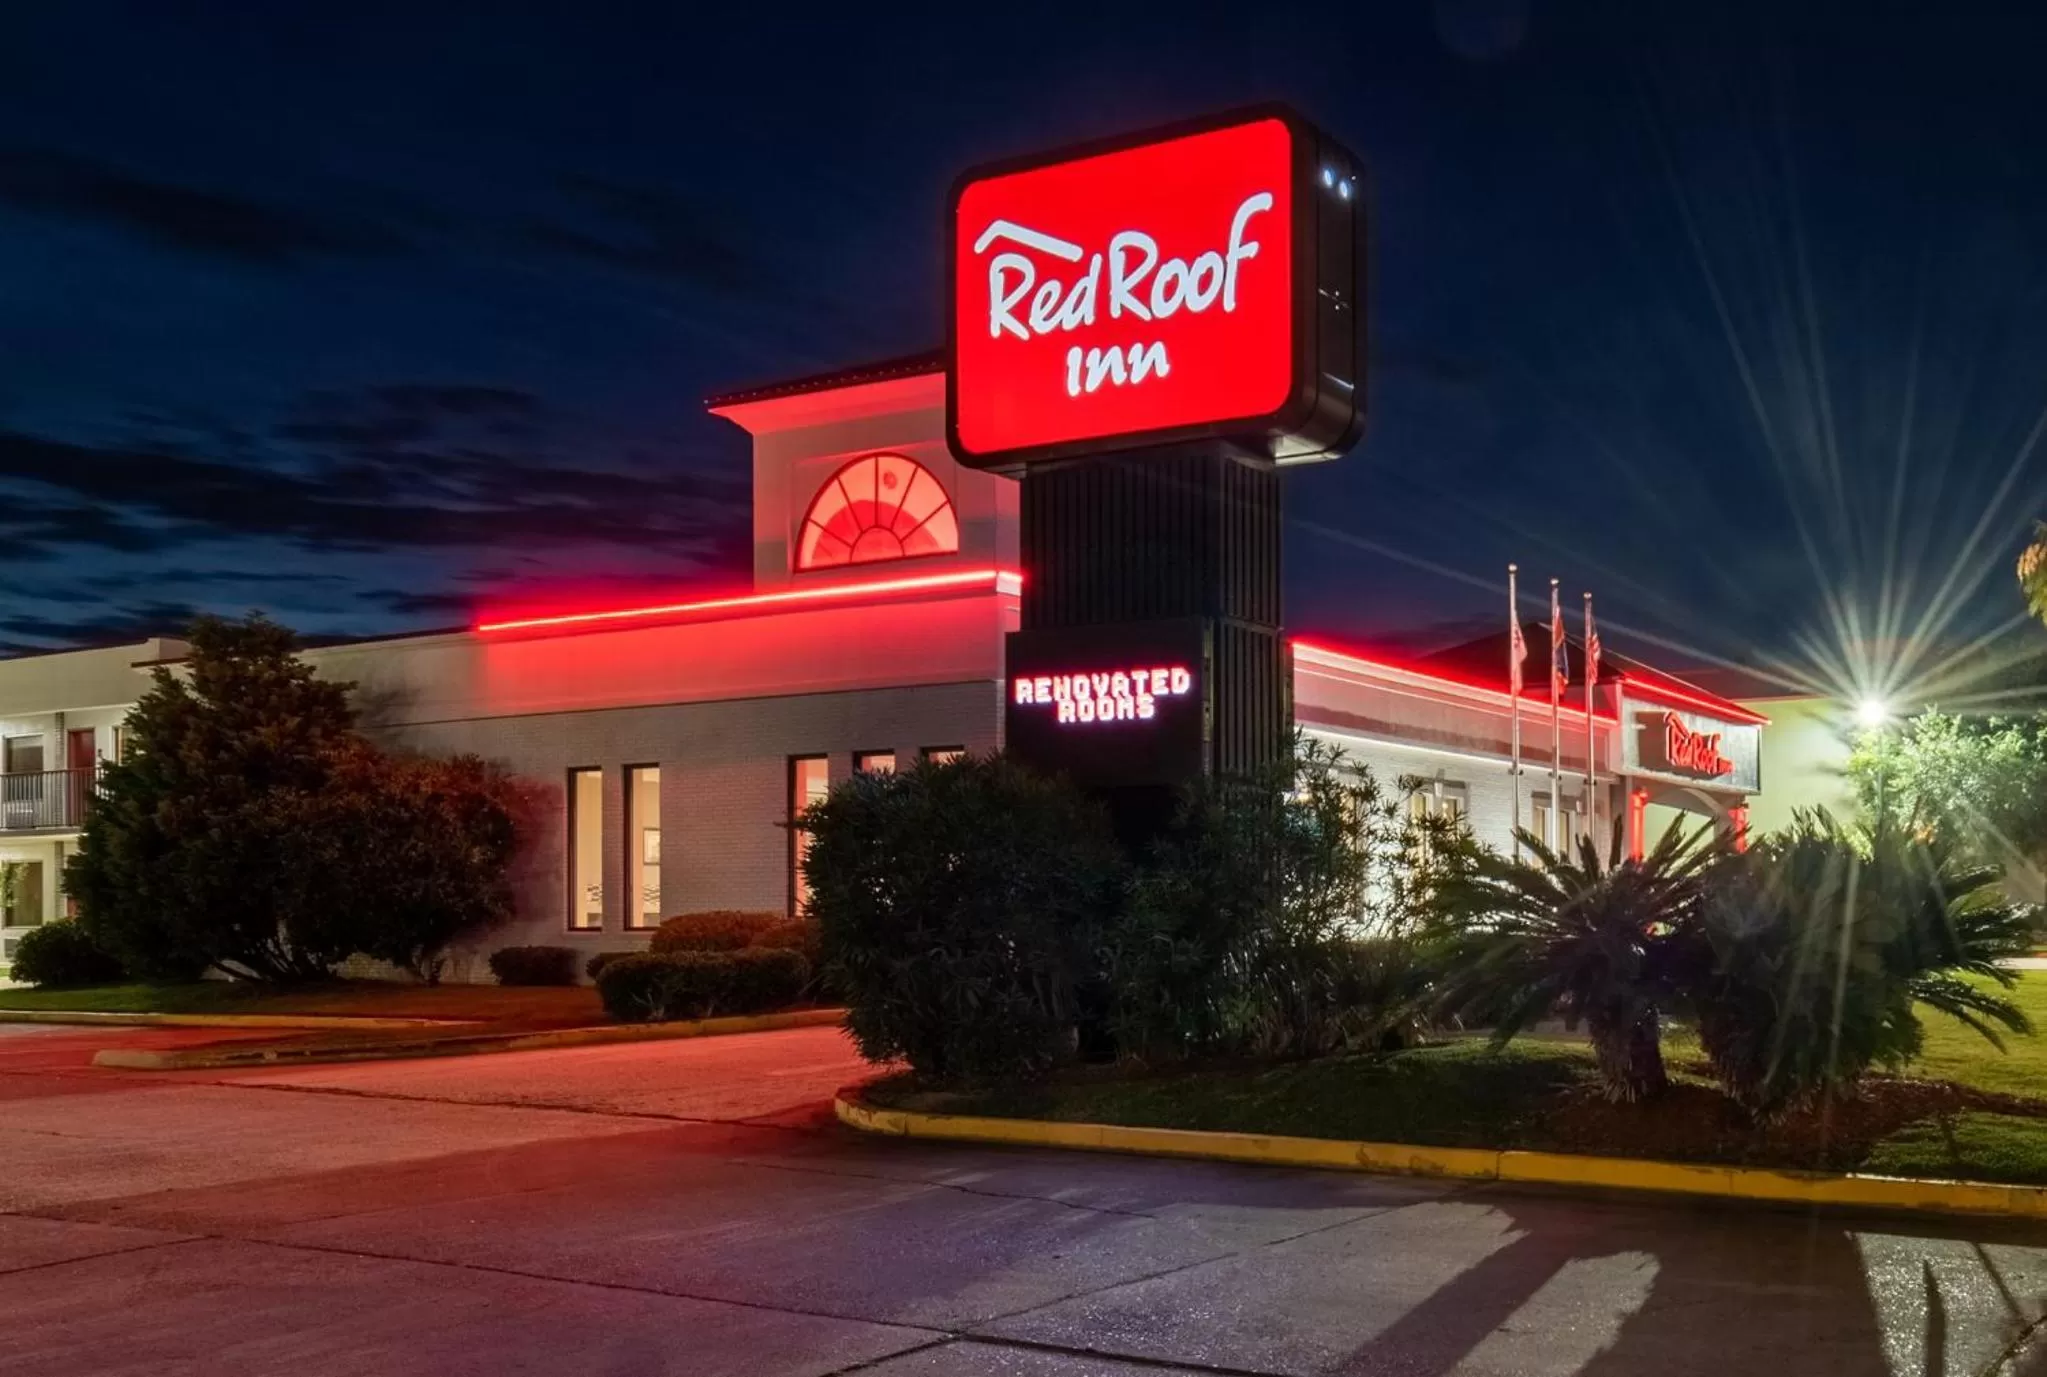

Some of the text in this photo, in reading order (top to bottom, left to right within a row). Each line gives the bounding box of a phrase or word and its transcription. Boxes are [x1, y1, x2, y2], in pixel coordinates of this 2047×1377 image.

[990, 192, 1273, 339] Red Roof
[1016, 668, 1190, 704] RENOVATED
[1059, 695, 1154, 723] ROOMS
